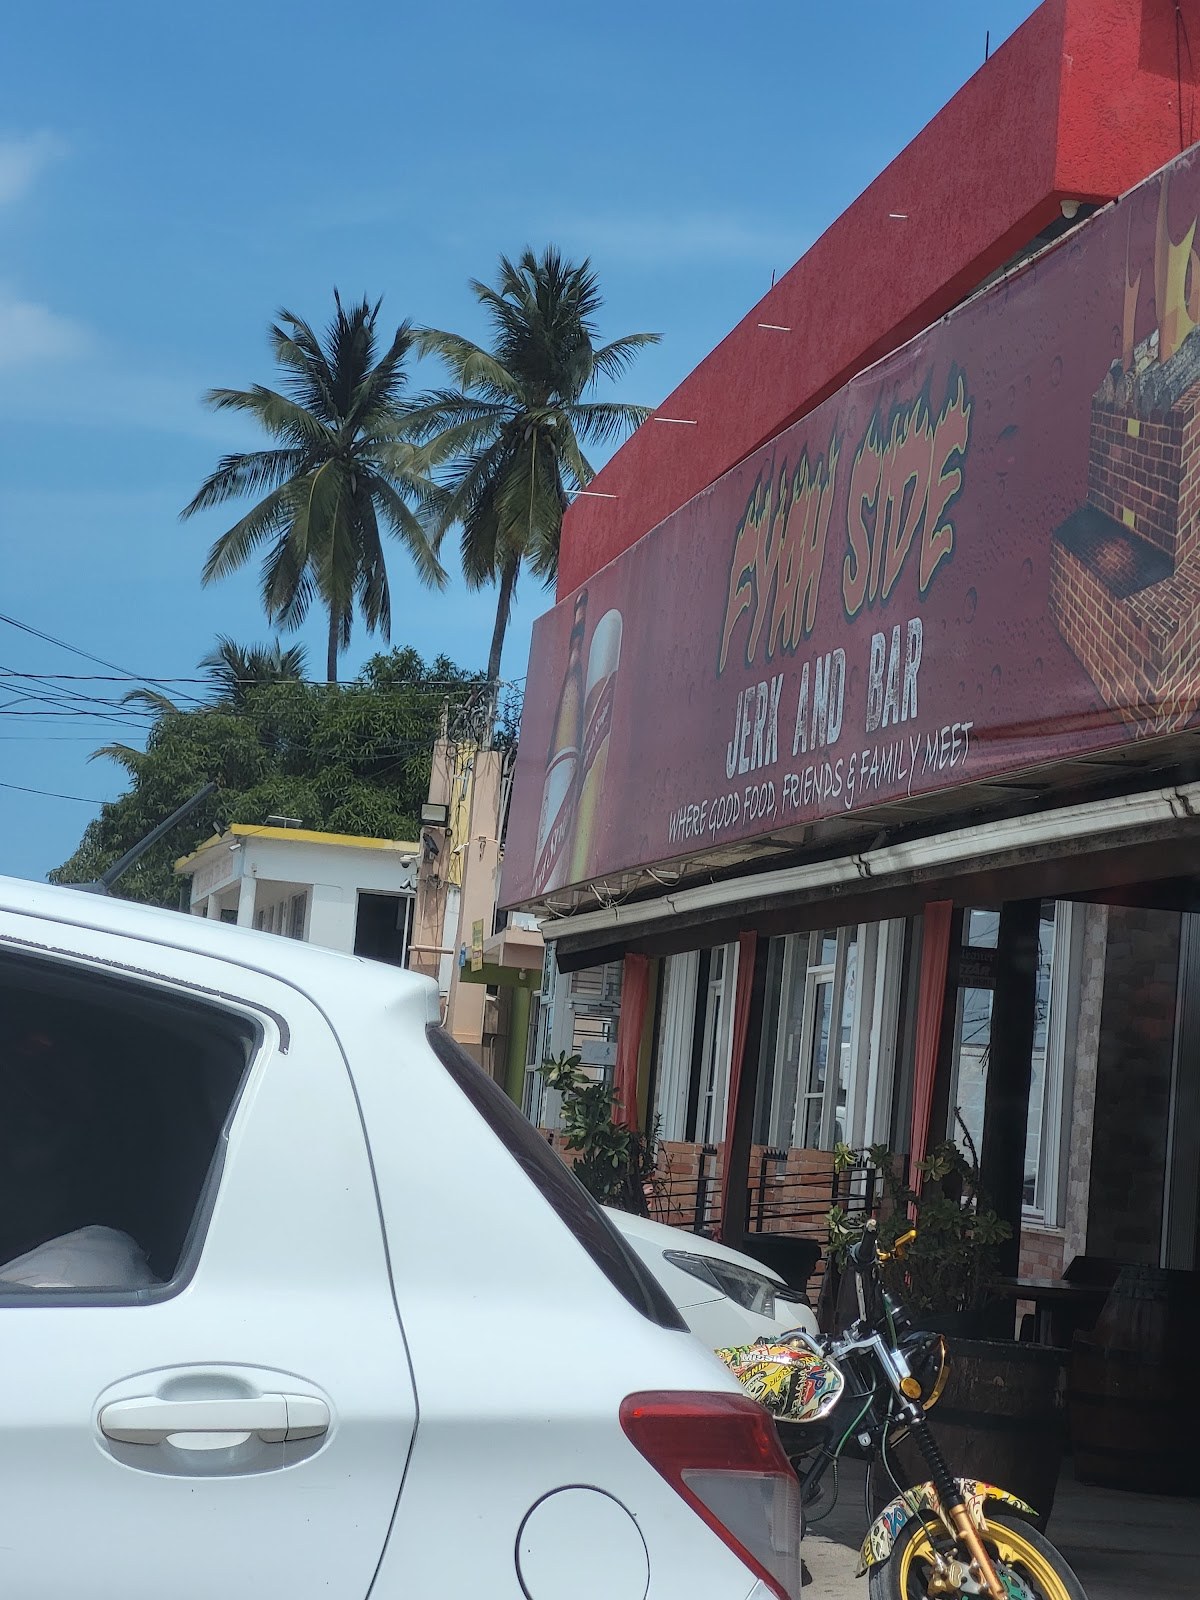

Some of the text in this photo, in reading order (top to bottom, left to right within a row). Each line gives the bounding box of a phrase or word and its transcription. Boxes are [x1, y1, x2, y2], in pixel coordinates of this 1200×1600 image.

[719, 375, 971, 673] FYAH SIDE
[725, 673, 783, 779] JERK
[792, 648, 846, 756] AND
[866, 617, 923, 732] BAR
[668, 801, 707, 843] WHERE
[708, 793, 740, 839] GOOD
[743, 781, 778, 823] FOOD,
[782, 759, 843, 813] FRIENDS
[859, 731, 922, 796] FAMILY
[922, 721, 974, 773] MEET
